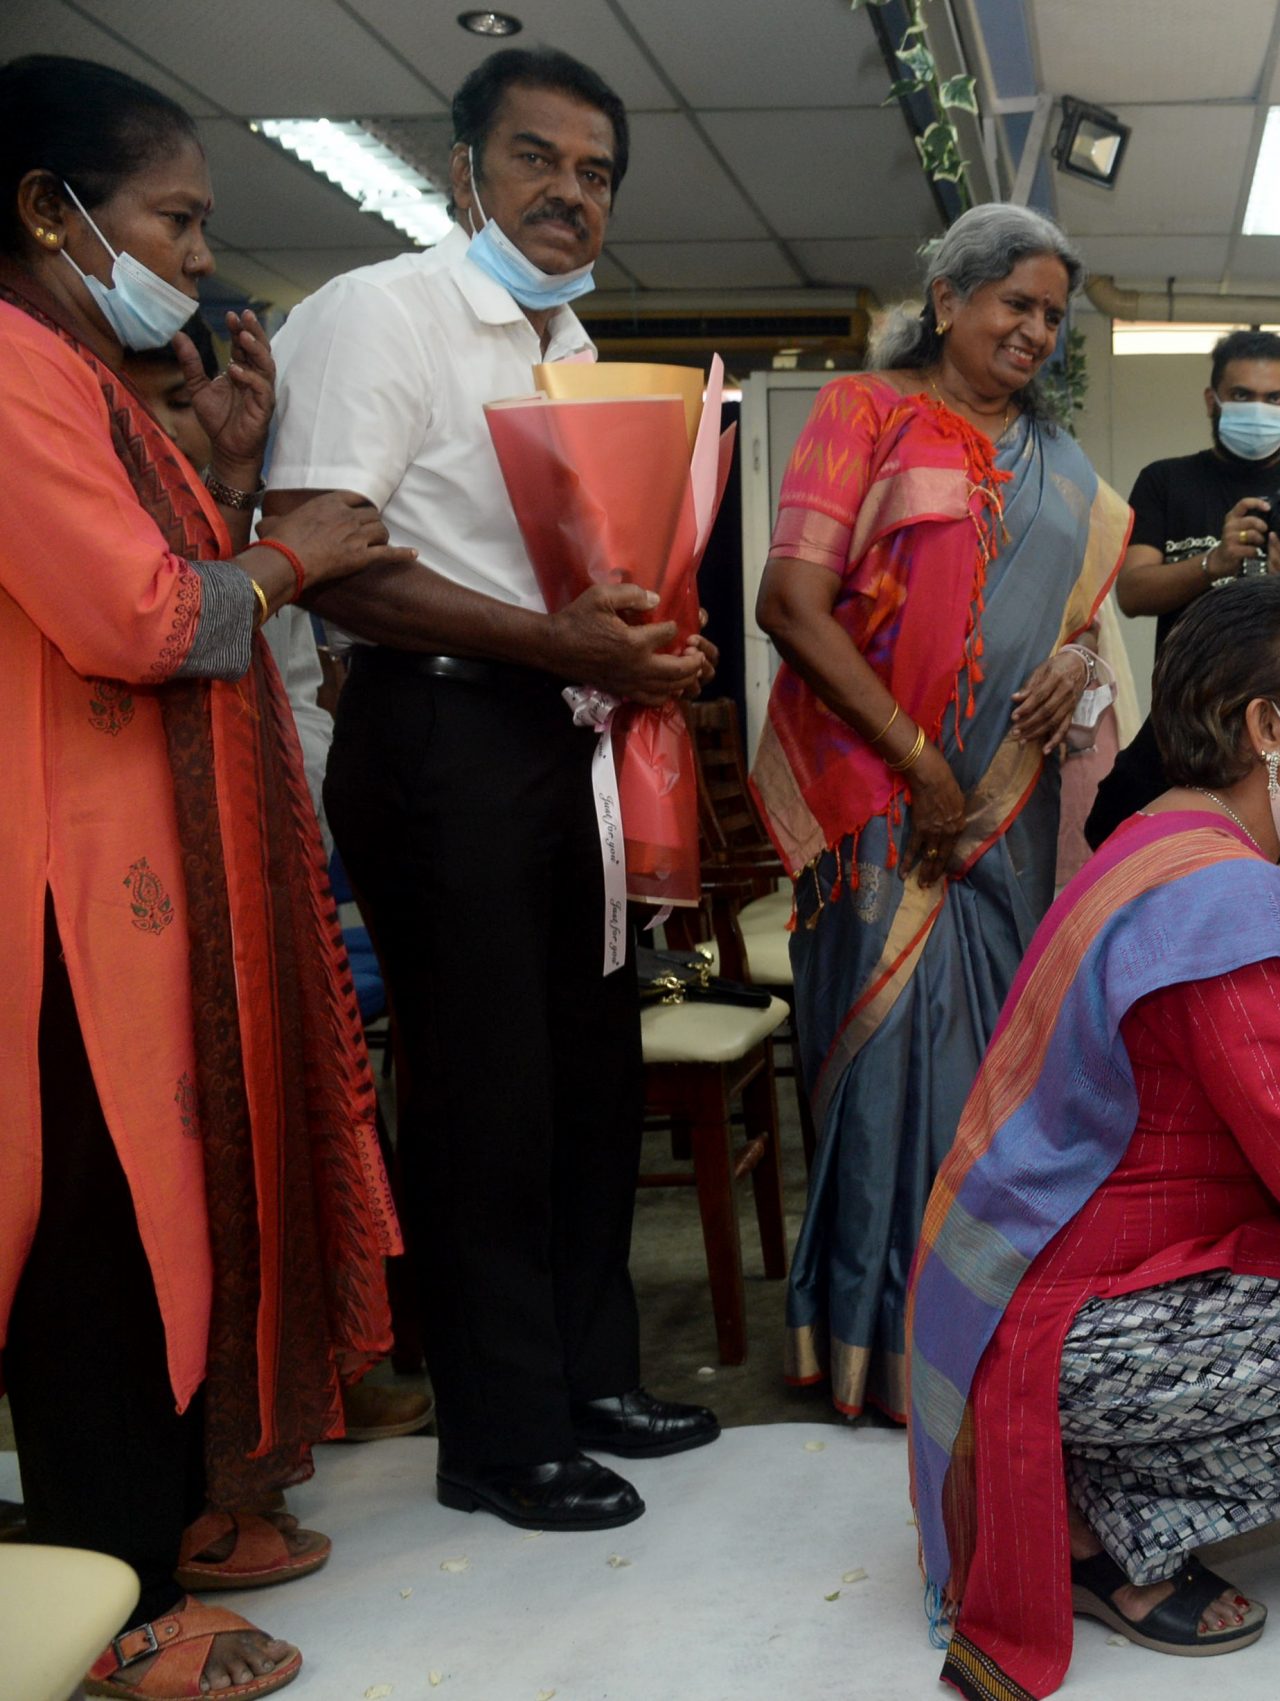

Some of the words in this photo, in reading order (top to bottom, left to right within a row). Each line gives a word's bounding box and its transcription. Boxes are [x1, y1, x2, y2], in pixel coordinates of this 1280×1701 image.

[602, 815, 617, 839] for
[606, 838, 617, 863] you
[609, 920, 620, 942] for
